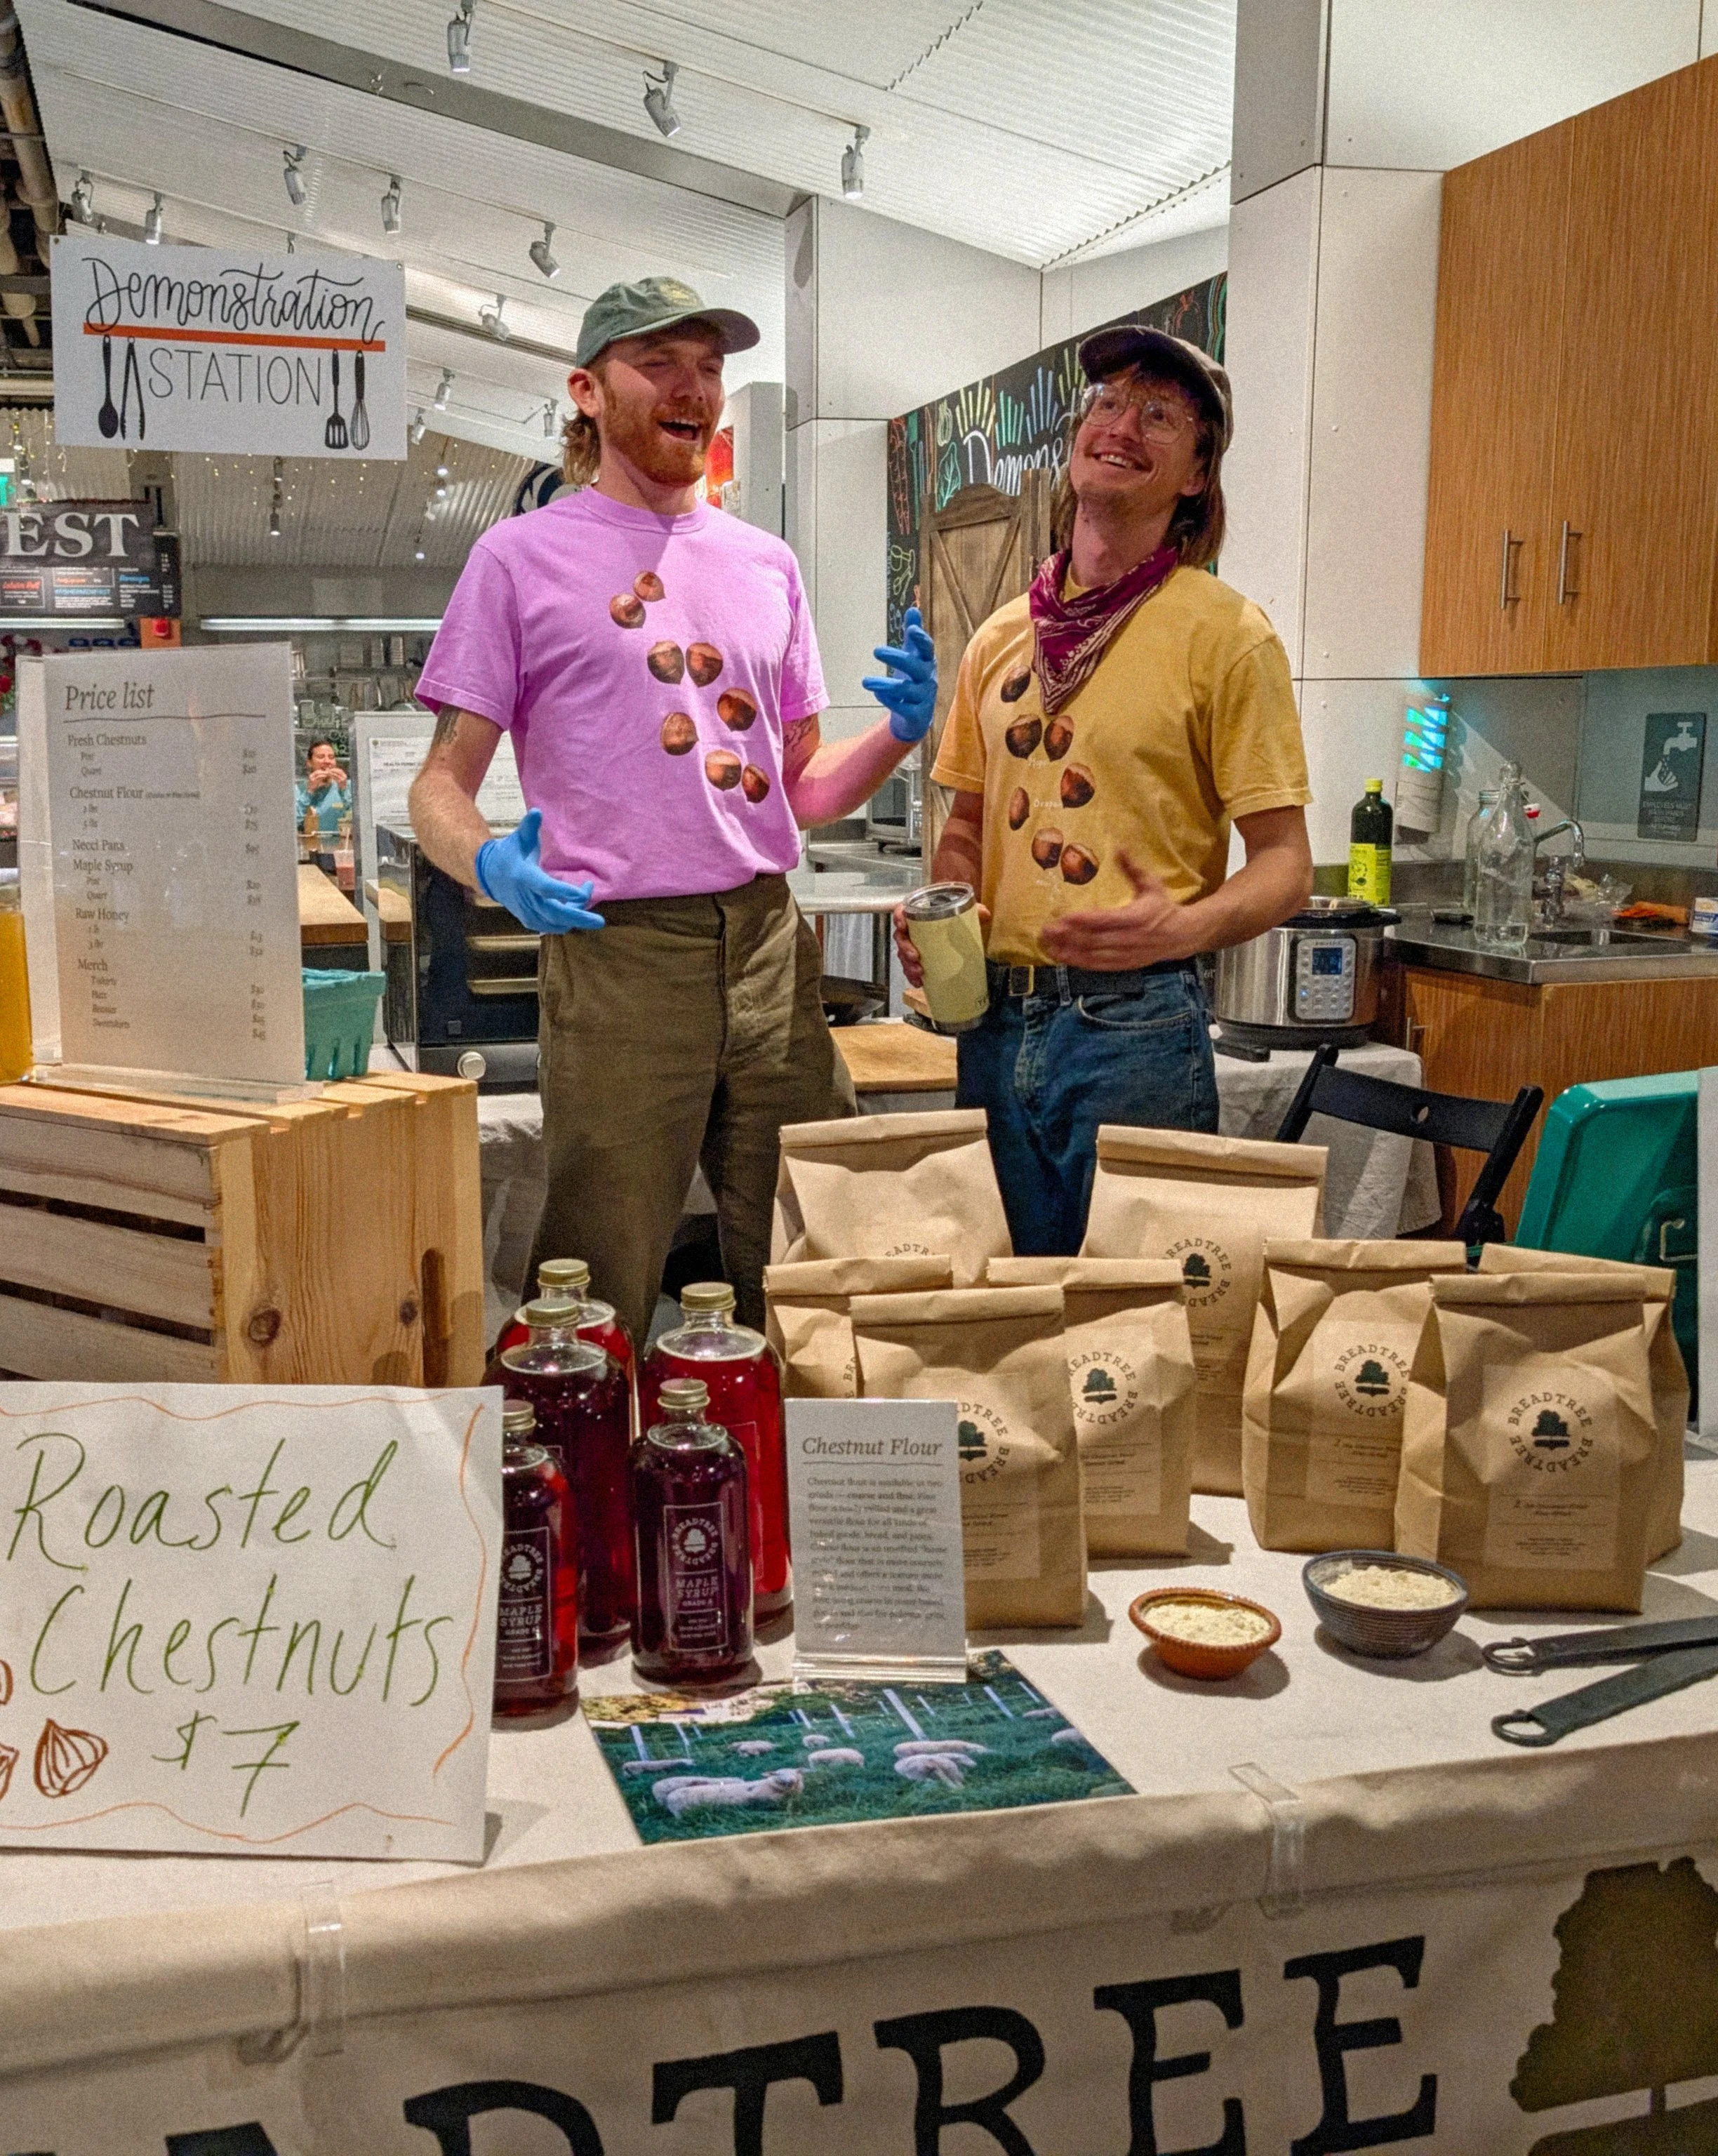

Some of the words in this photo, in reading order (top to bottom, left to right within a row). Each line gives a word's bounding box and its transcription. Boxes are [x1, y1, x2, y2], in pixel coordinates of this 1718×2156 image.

[81, 258, 385, 345] Demonstration
[148, 347, 321, 406] STATION
[2, 512, 140, 557] EST
[65, 683, 116, 710] Price
[123, 681, 155, 709] list
[67, 733, 95, 747] Fresh
[96, 733, 147, 746] Chestnuts
[69, 786, 114, 799] Chestnut
[116, 785, 144, 799] Flour
[73, 858, 102, 875] Maple
[105, 858, 133, 876] Syrup
[75, 907, 95, 919] Raw
[98, 907, 129, 924] Honey
[77, 958, 108, 971] Merch
[1161, 1237, 1232, 1271] READTREE
[1067, 1352, 1136, 1380] EADTREE
[1507, 1392, 1592, 1427] BREADTREE
[801, 1436, 884, 1456] Chestnut
[890, 1437, 943, 1456] Flour
[1510, 1435, 1593, 1473] BREADTREE
[6, 1432, 398, 1571] Roasted
[676, 1576, 719, 1589] MAPLE
[677, 1586, 719, 1599] SYRUP
[500, 1604, 543, 1617] MAPLE
[500, 1614, 542, 1628] SYRUP
[29, 1573, 453, 1707] Chestnuts
